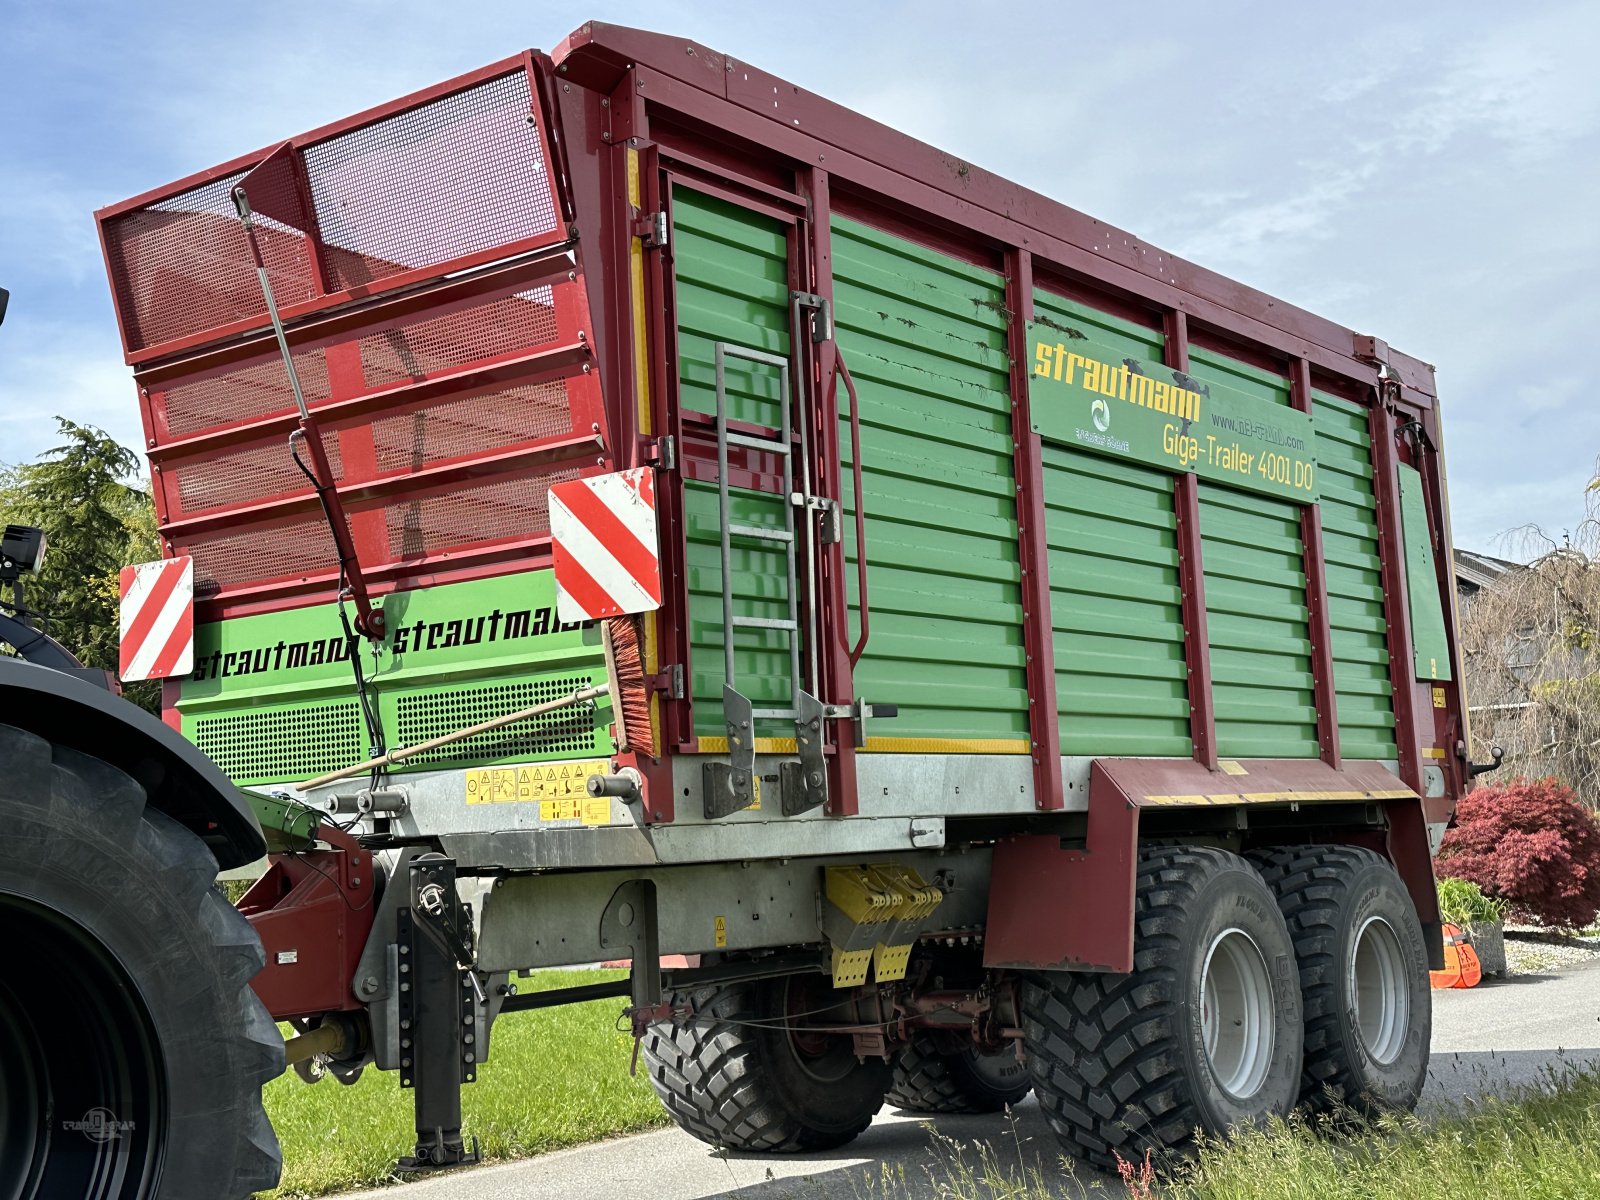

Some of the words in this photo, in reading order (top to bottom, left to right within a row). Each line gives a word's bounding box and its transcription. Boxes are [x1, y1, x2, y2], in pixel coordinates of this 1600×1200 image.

[1034, 342, 1201, 423] strautmann
[1163, 423, 1255, 475] Giga-Trailer
[1258, 450, 1291, 485] 4001
[1295, 460, 1313, 491] DO
